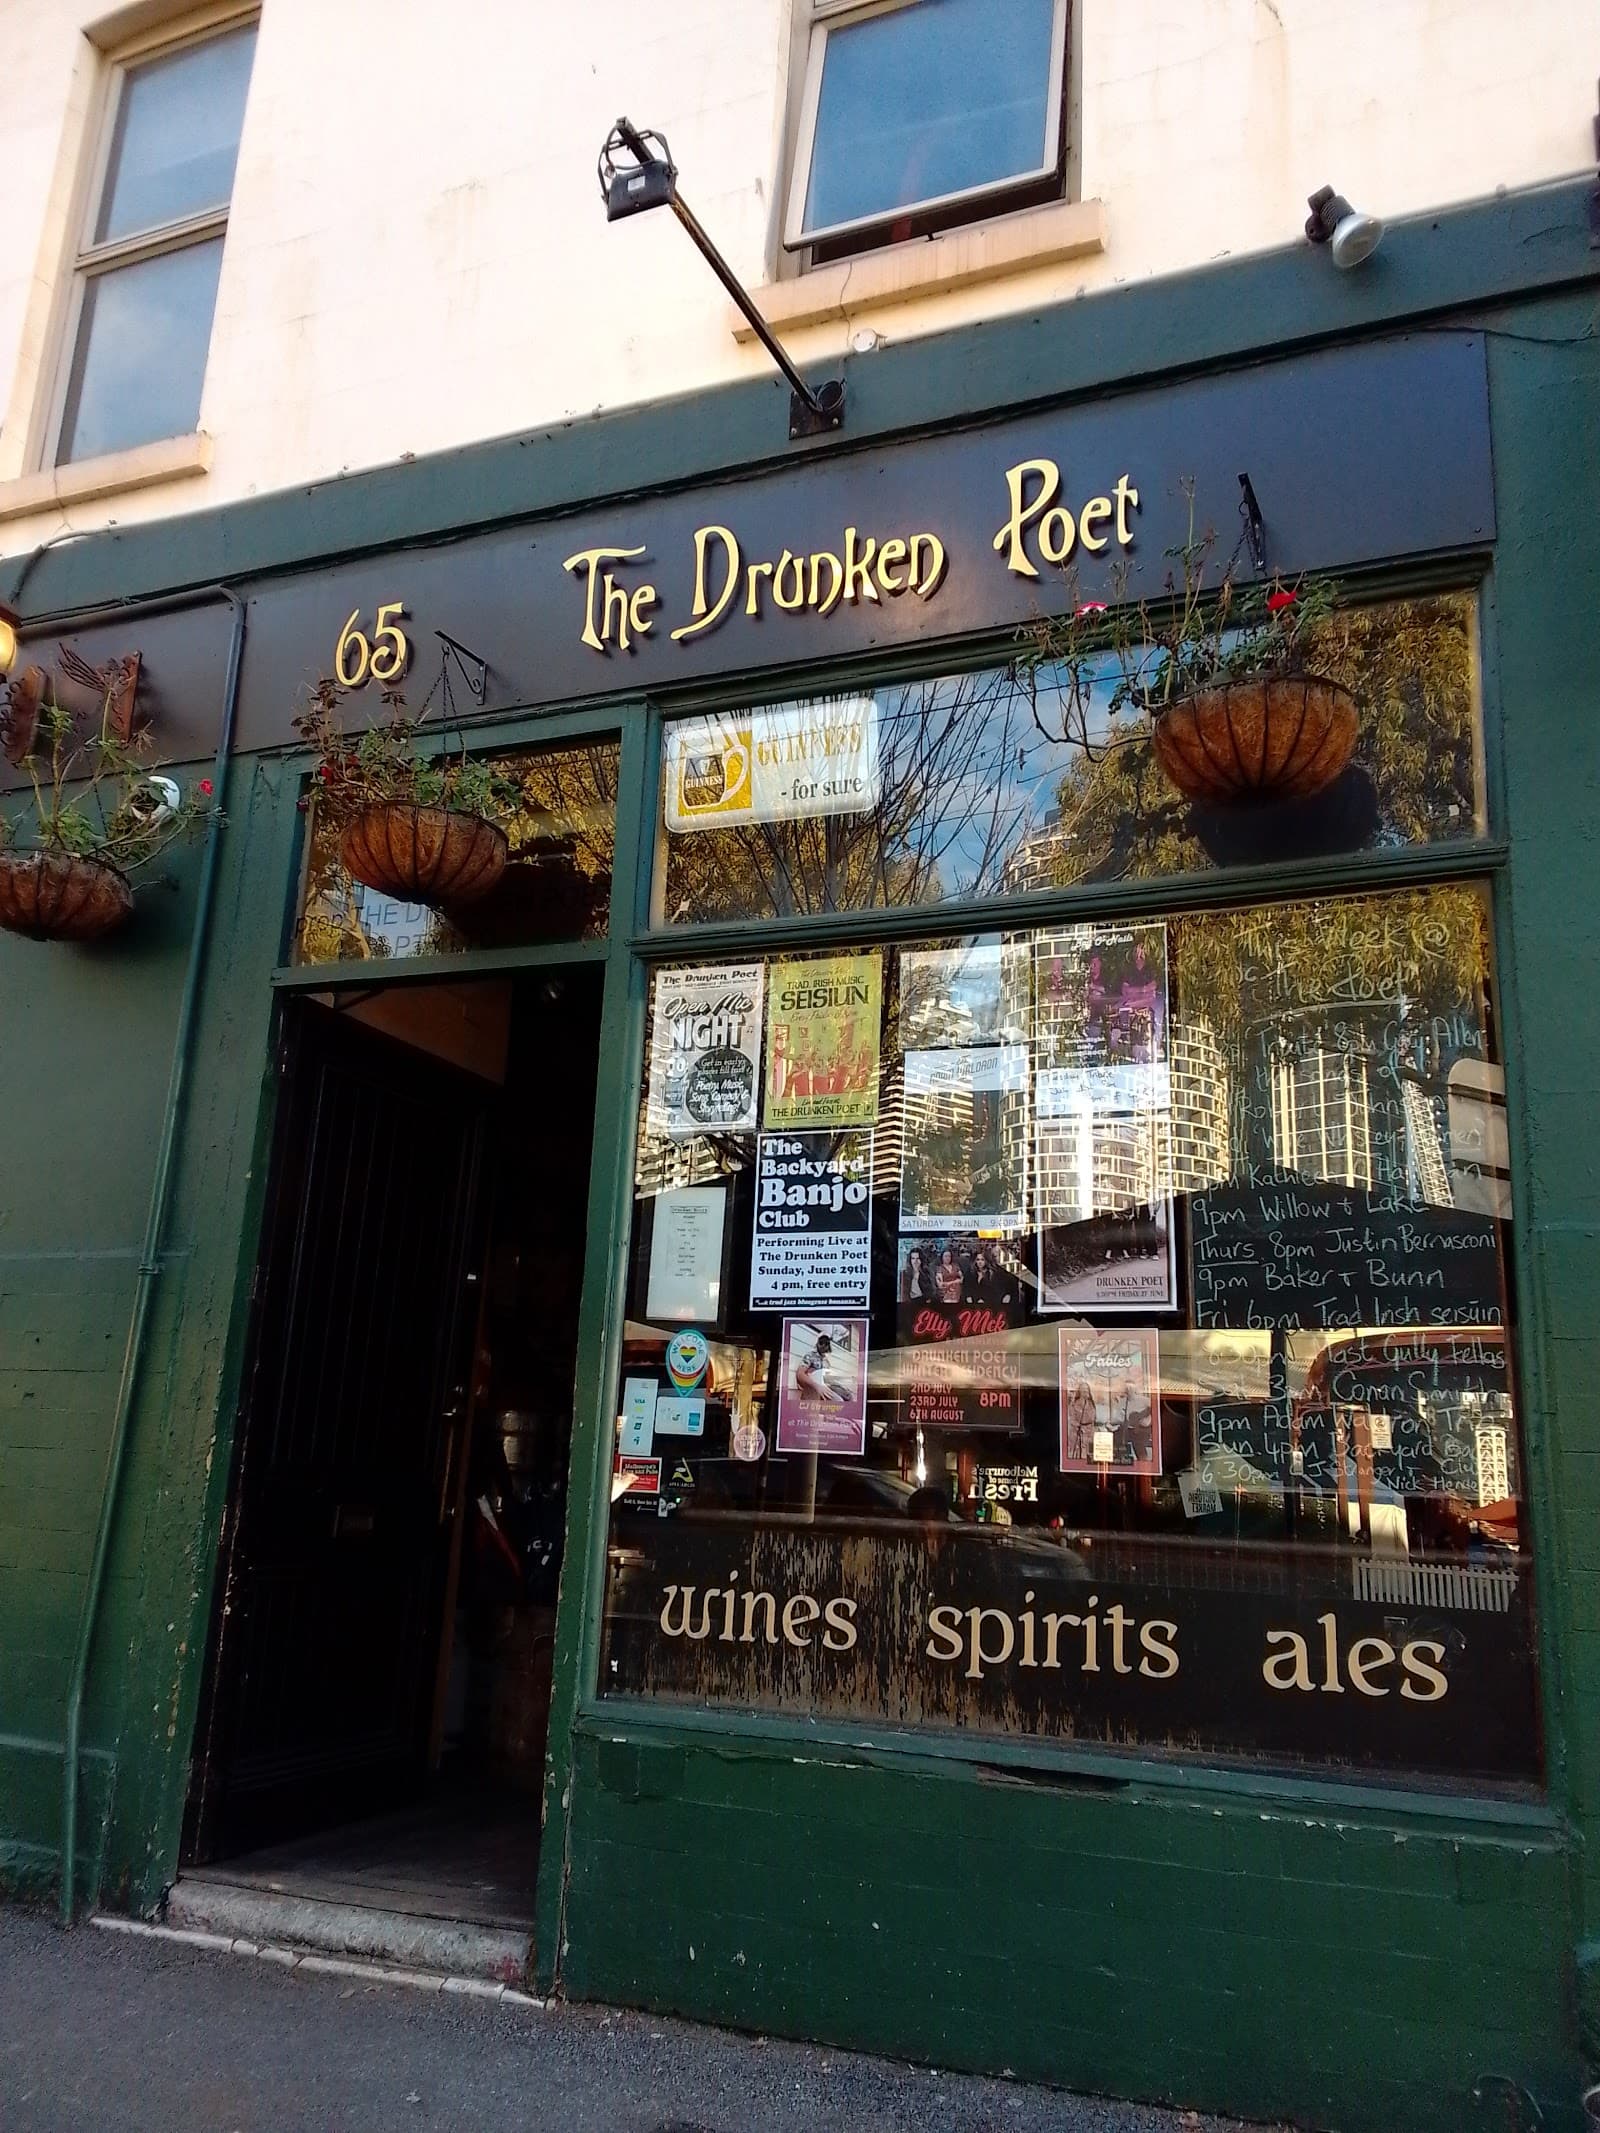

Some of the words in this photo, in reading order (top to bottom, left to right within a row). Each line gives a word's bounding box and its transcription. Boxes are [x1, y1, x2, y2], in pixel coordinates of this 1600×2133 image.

[562, 545, 656, 651] The
[670, 525, 945, 642] Drunken
[992, 458, 1140, 577] Poet
[335, 601, 408, 688] 65
[685, 775, 723, 789] GUINNESS
[791, 778, 818, 800] for
[823, 777, 863, 797] sure
[663, 976, 681, 985] The
[663, 997, 710, 1019] Open
[711, 991, 757, 1016] Mic
[780, 985, 869, 1010] SEISIUN
[669, 1012, 745, 1050] NIGHT
[772, 1107, 788, 1117] THE
[791, 1103, 834, 1117] DRUNKEN
[836, 1103, 861, 1113] POET
[762, 1139, 803, 1156] The
[761, 1156, 865, 1178] Backyard
[759, 1176, 868, 1213] Banjo
[758, 1210, 810, 1228] Club
[902, 1219, 944, 1228] SATURDAY
[1193, 1198, 1246, 1237] 9pm
[1259, 1192, 1330, 1221] Willow
[757, 1237, 825, 1248] Performing
[828, 1236, 853, 1245] Live
[856, 1236, 869, 1245] at
[1268, 1231, 1315, 1270] 8pm
[1323, 1227, 1398, 1254] Justin
[759, 1251, 781, 1261] The
[784, 1250, 837, 1260] Drunken
[842, 1249, 868, 1259] Poet
[758, 1265, 804, 1277] Sunday,
[807, 1265, 837, 1275] June
[839, 1264, 868, 1274] 29th
[1096, 1277, 1138, 1286] DRUNKEN
[1141, 1276, 1163, 1286] POET
[1198, 1268, 1249, 1301] 9pm
[1262, 1261, 1335, 1291] Baker
[1367, 1259, 1445, 1288] Bunn
[771, 1281, 778, 1290] 4
[781, 1281, 804, 1291] pm,
[806, 1279, 831, 1289] free
[833, 1279, 867, 1290] entry
[913, 1309, 952, 1338] Elly
[1246, 1299, 1301, 1330] 6pm
[1374, 1296, 1421, 1326] Irish
[671, 1334, 706, 1354] WELCOME
[1383, 1333, 1438, 1376] Gully
[912, 1350, 969, 1363] DRUNKEN
[974, 1350, 1008, 1363] POET
[1084, 1353, 1133, 1369] Fables
[910, 1383, 931, 1393] 2ND
[933, 1383, 953, 1393] JULY
[1332, 1371, 1406, 1402] Conan
[910, 1396, 937, 1406] 23RD
[939, 1396, 958, 1407] JULY
[979, 1392, 1011, 1408] 8PM
[930, 1409, 965, 1421] AUGUST
[1198, 1408, 1252, 1443] 9pm
[1263, 1404, 1326, 1430] Adam
[1263, 1432, 1320, 1464] 4pm
[1386, 1476, 1425, 1491] Nick
[659, 1570, 859, 1651] wines
[926, 1590, 1181, 1680] spirits
[1262, 1613, 1449, 1702] ales
